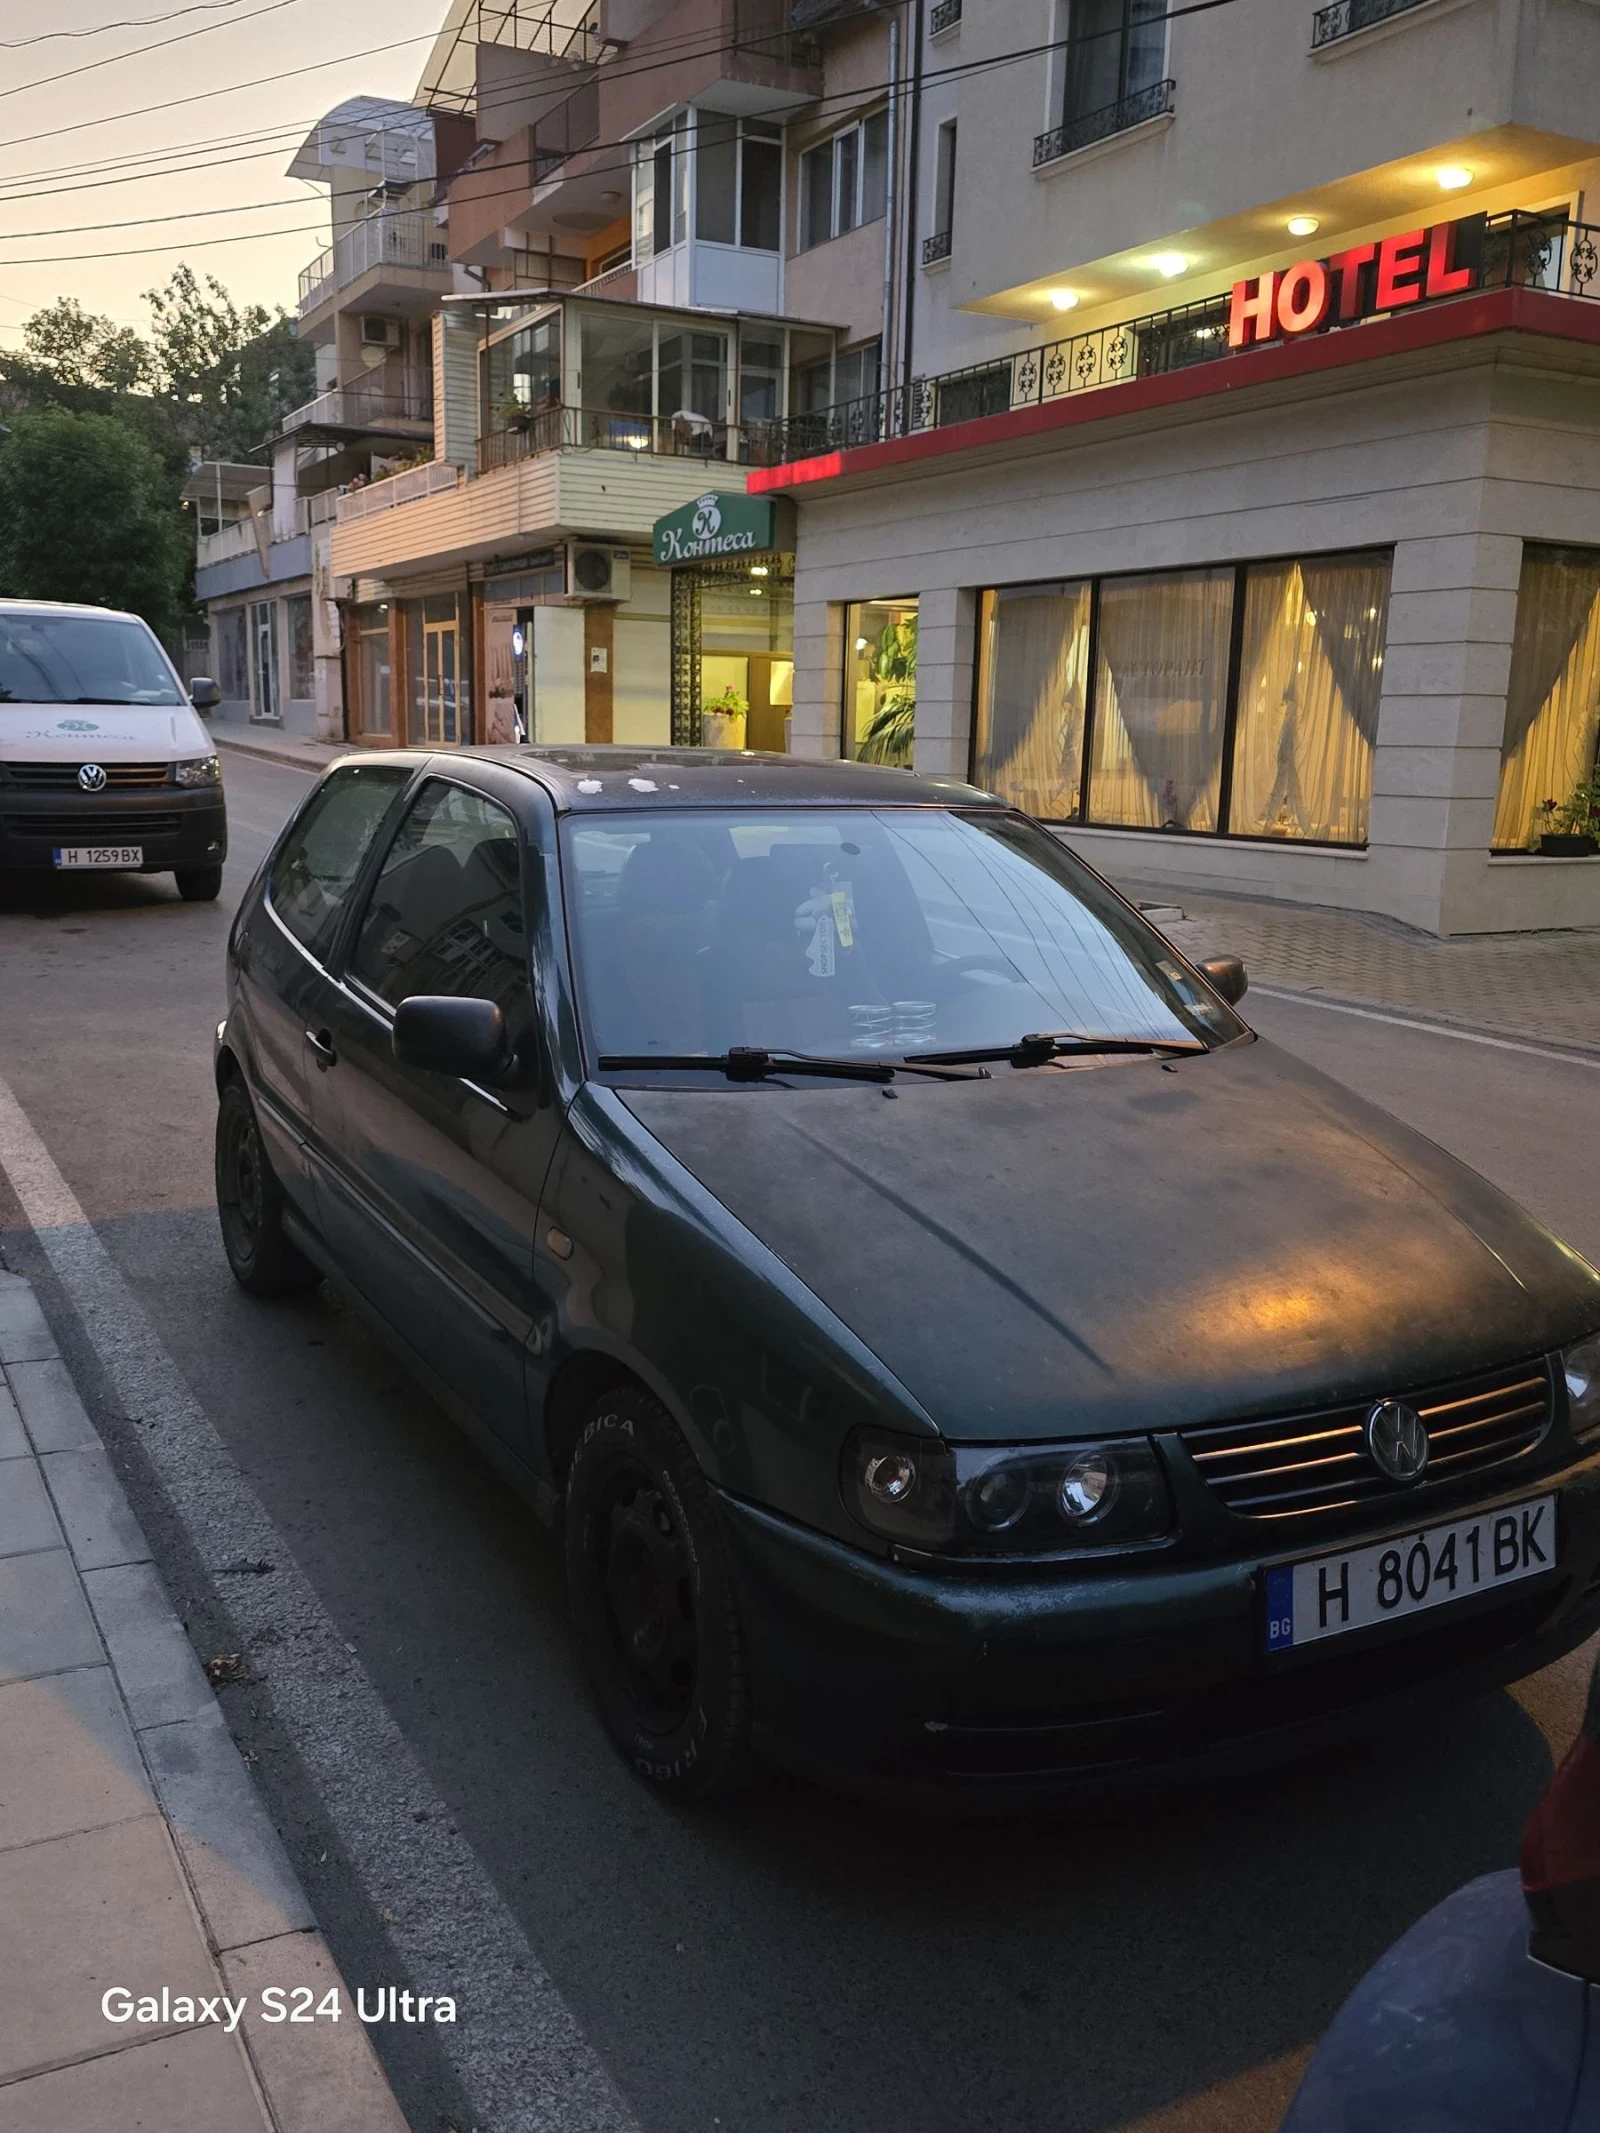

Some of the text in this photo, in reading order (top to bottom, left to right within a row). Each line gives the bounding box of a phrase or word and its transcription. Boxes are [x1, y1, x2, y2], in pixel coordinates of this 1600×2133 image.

[1229, 223, 1473, 347] HOTEL
[660, 528, 756, 561] Контеса
[68, 851, 78, 864] H
[1319, 1562, 1349, 1628] H
[1269, 1617, 1291, 1639] BG
